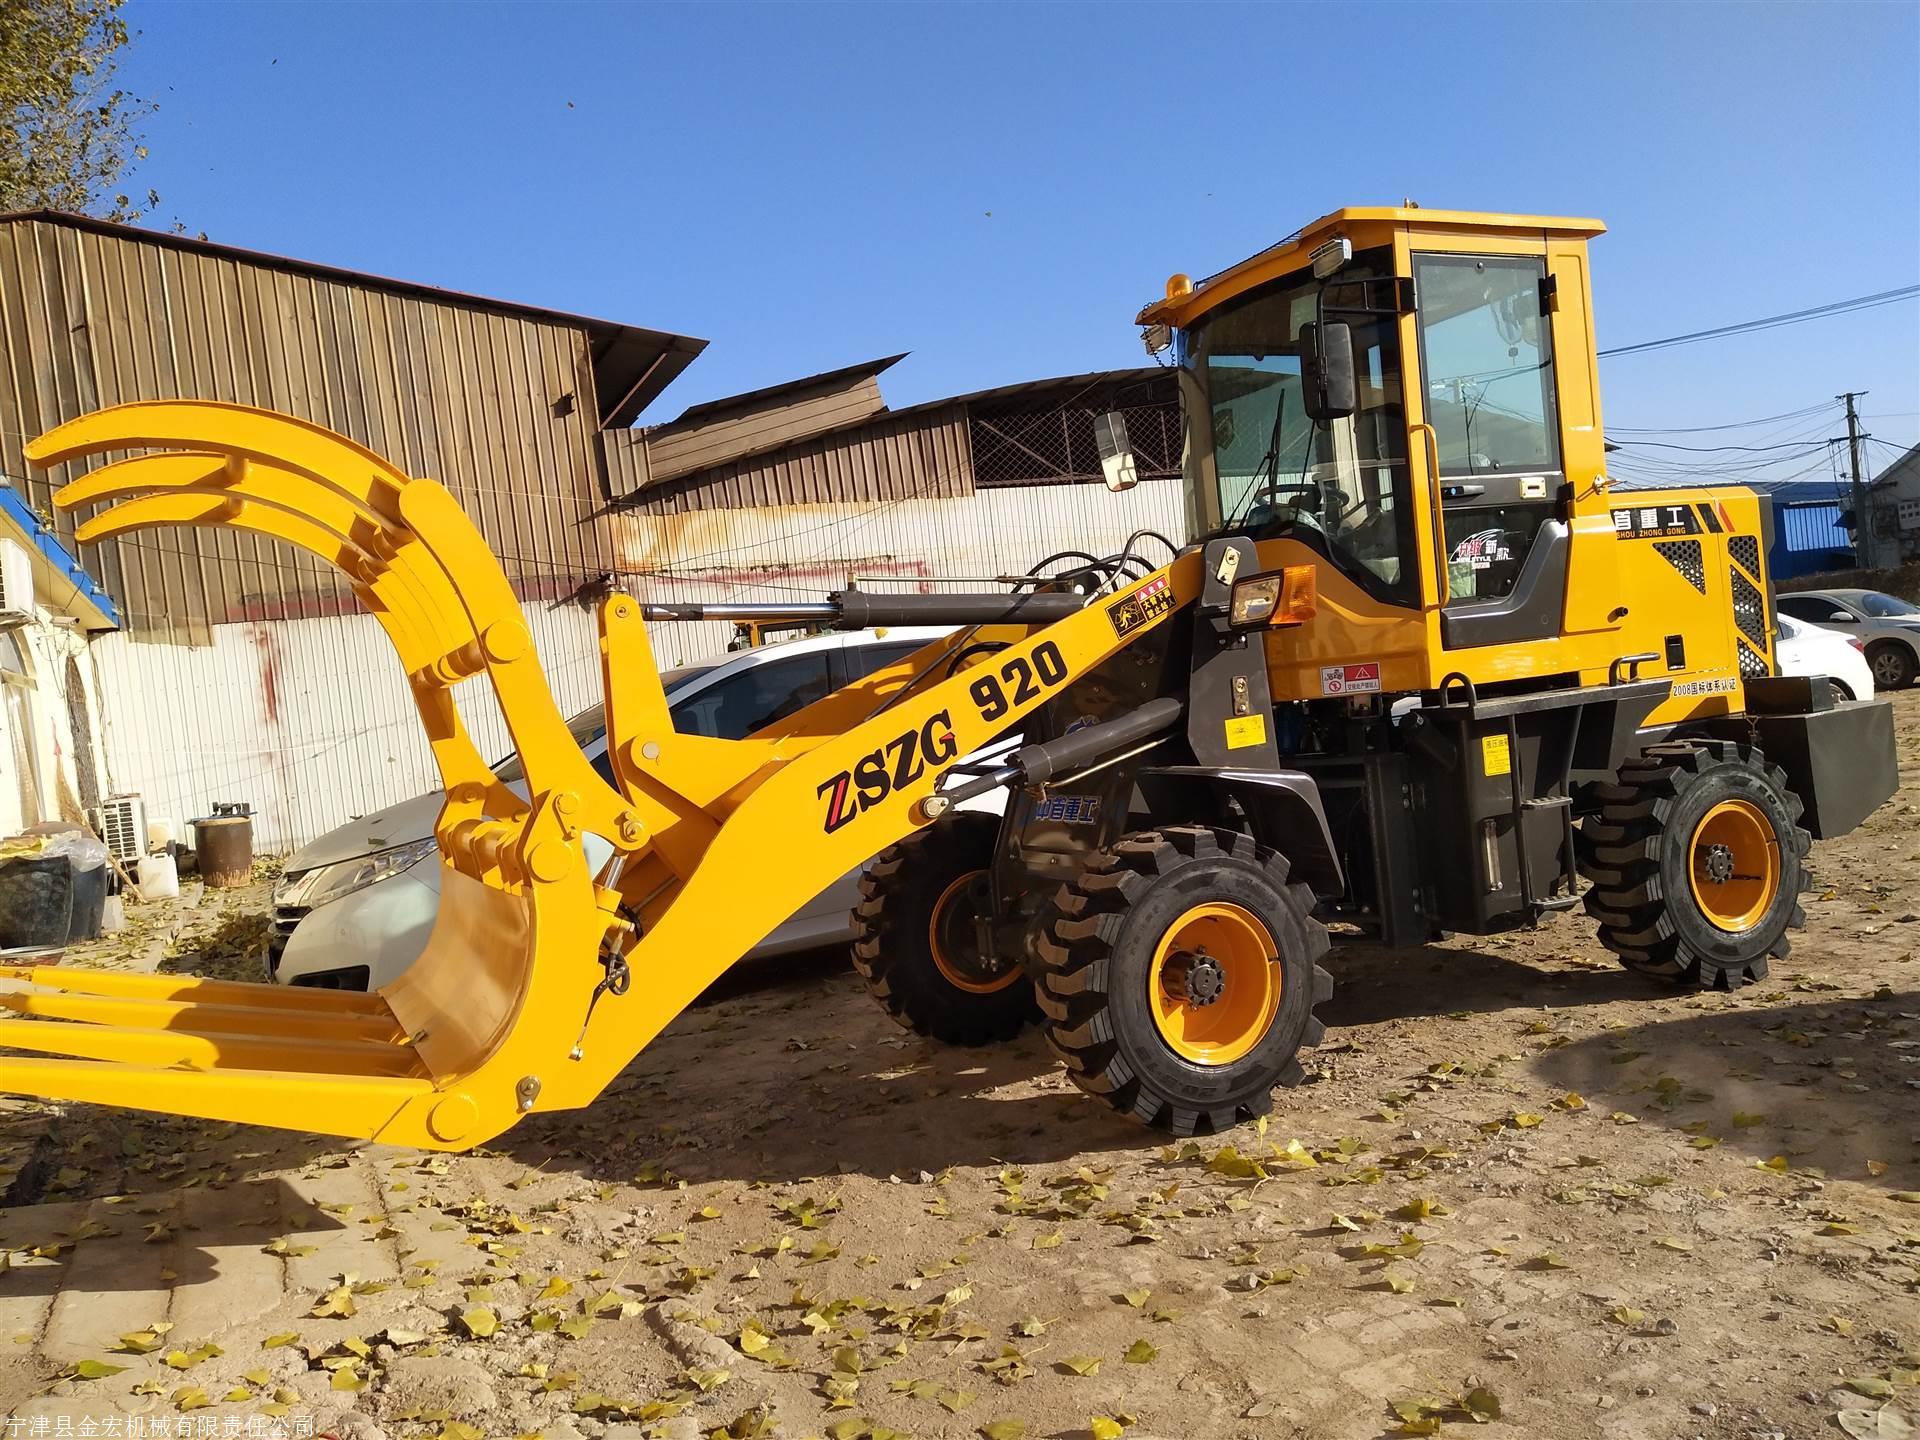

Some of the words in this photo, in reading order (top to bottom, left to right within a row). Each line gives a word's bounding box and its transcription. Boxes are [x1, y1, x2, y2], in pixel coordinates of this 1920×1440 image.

[1616, 530, 1636, 539] SHOU
[1639, 528, 1663, 538] ZHONG
[1666, 527, 1686, 535] GONG
[817, 708, 959, 834] ZSZG
[969, 640, 1069, 722] 920
